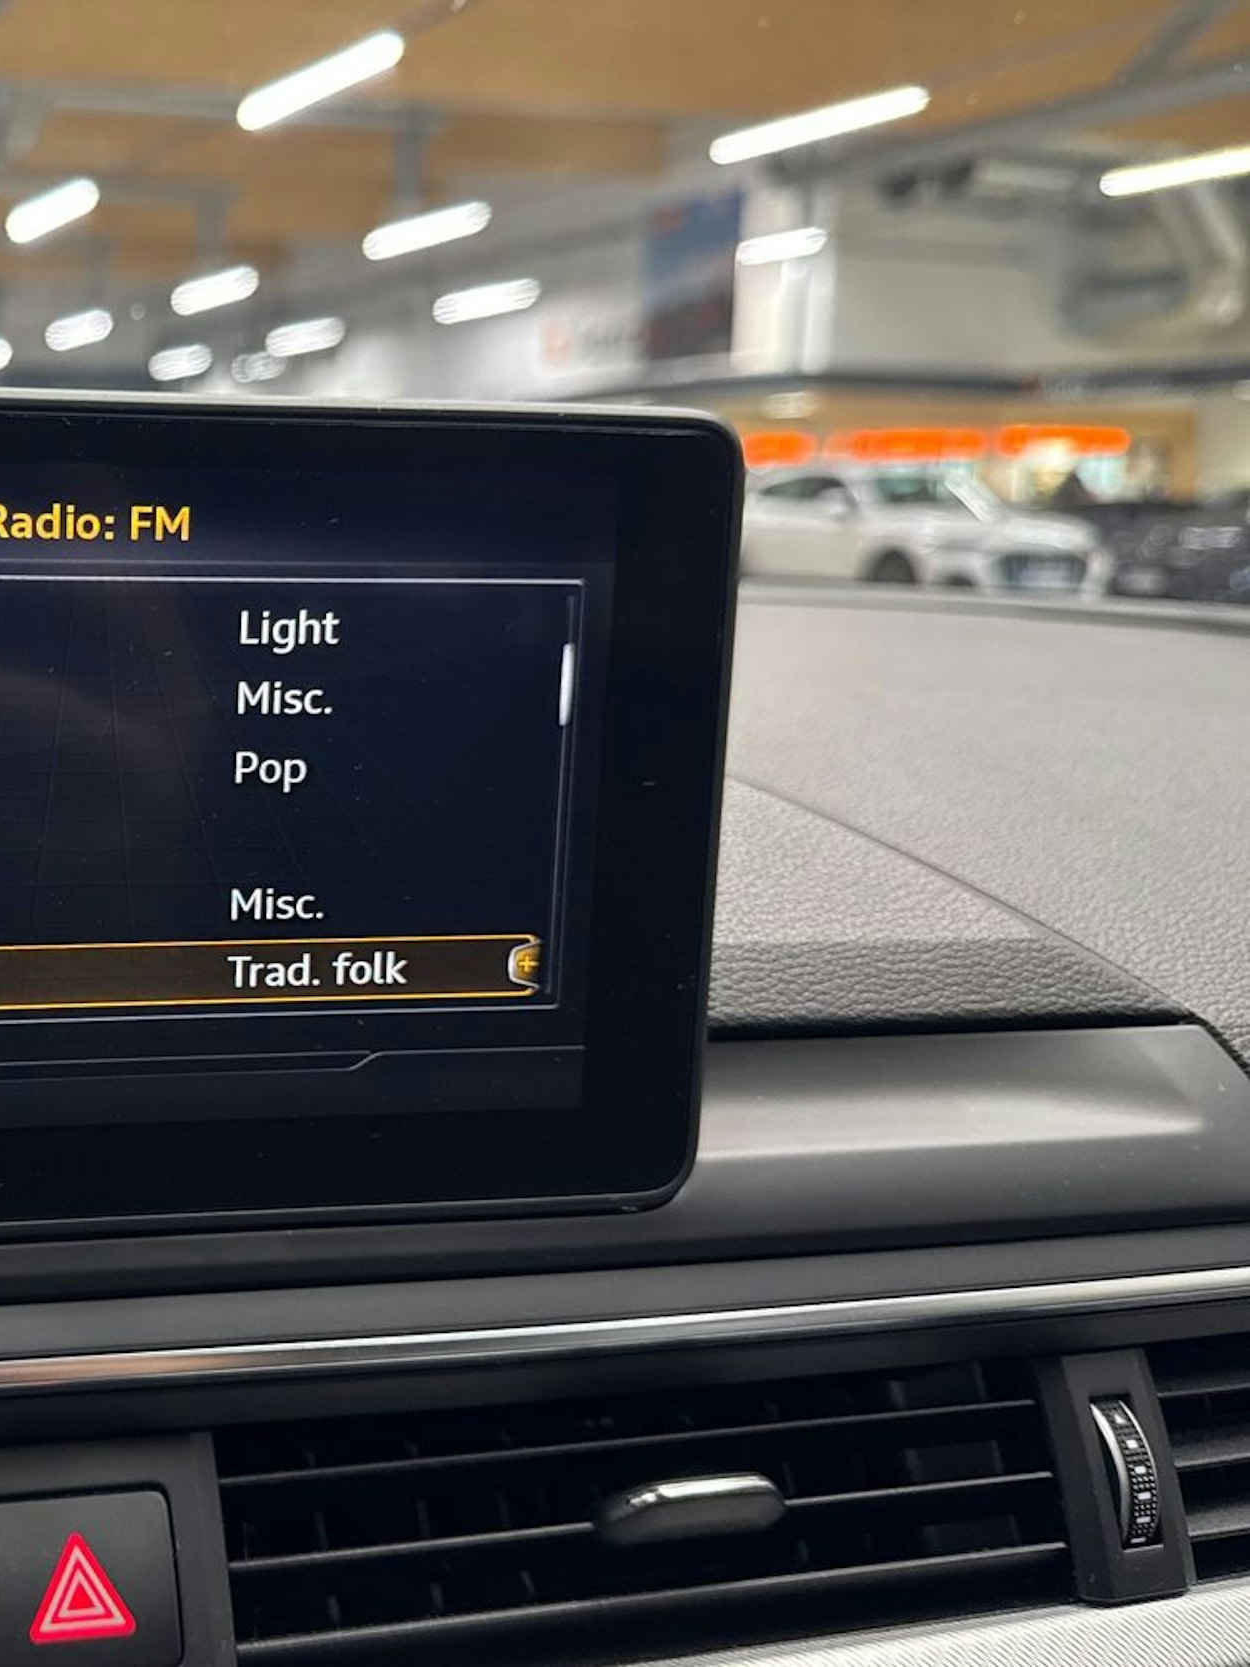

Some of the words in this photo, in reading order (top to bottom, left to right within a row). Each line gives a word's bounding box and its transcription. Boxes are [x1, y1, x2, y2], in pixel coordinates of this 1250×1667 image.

[130, 505, 191, 542] FM
[239, 609, 340, 655] Light
[237, 680, 333, 715] Misc.
[235, 750, 308, 794] Pop
[230, 887, 324, 921] Misc.
[227, 952, 321, 988] Trad.
[331, 950, 408, 986] folk
